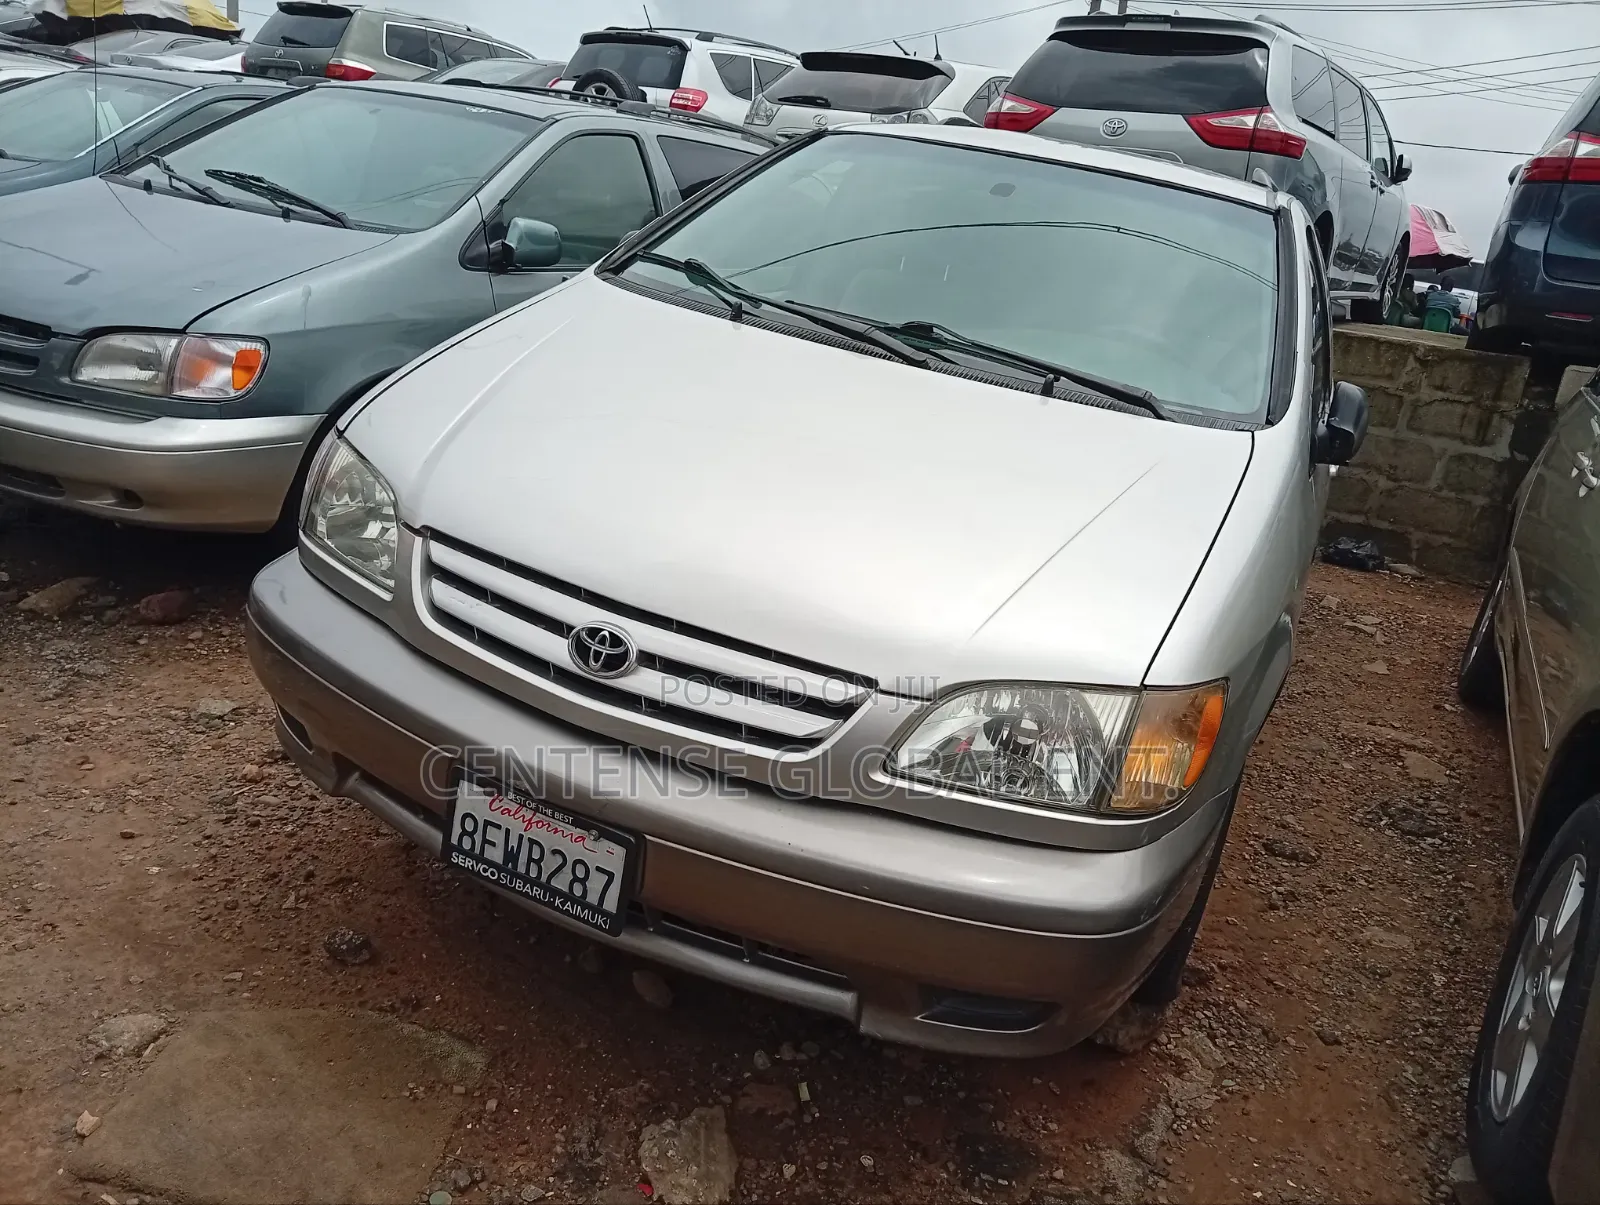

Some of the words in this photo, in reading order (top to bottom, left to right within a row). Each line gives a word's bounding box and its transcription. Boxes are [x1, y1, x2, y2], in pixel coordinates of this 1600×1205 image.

[489, 794, 598, 854] California
[507, 791, 526, 806] BEST
[526, 799, 537, 809] OF
[538, 805, 553, 818] THE
[554, 811, 574, 825] BEST
[451, 851, 498, 880] SERVCO
[499, 872, 550, 903] SUBARU
[554, 895, 610, 930] KAIMUKI
